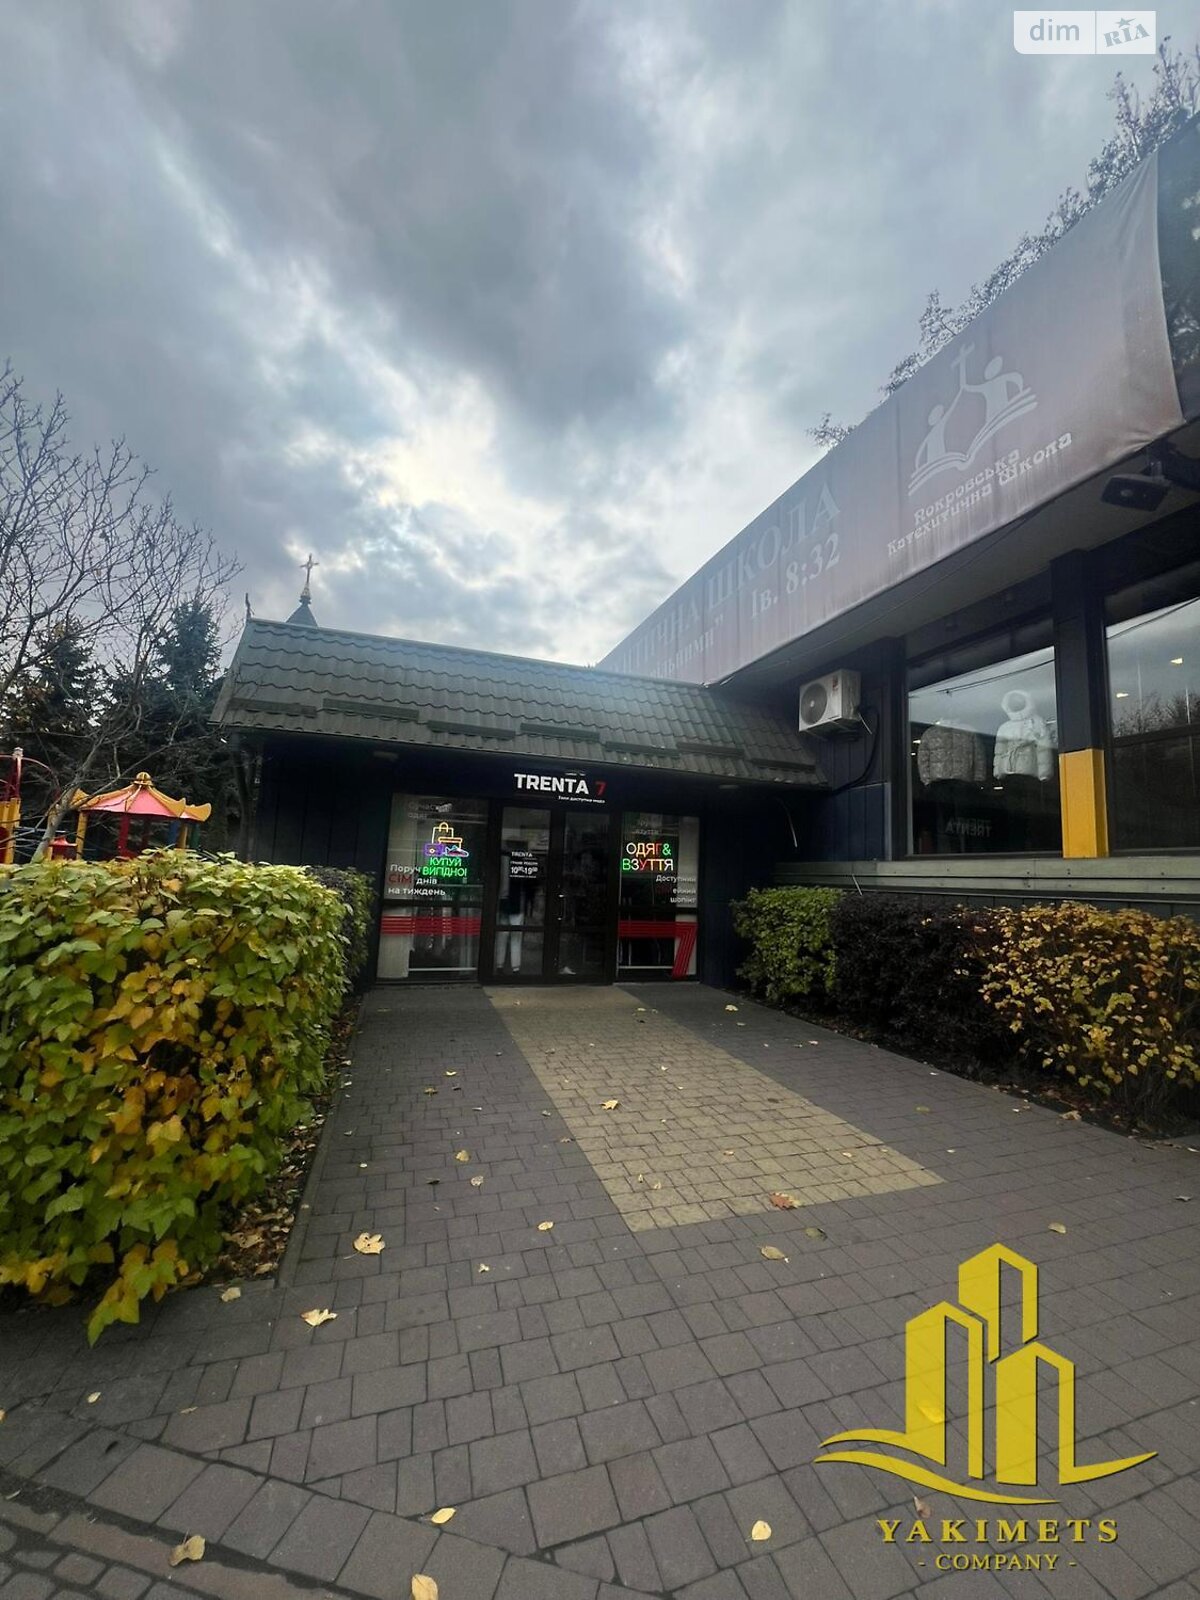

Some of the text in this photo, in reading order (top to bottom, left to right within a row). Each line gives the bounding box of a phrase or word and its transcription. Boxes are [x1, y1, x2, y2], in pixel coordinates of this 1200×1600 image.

[707, 482, 842, 611] ШКОЛА
[785, 533, 841, 595] 8:32
[513, 773, 607, 797] TRENTA 7
[626, 842, 671, 858] ОДЯГ &
[429, 857, 462, 867] КУПУЙ
[622, 858, 674, 871] ВЗУТТЯ
[389, 864, 421, 875] Поруч
[416, 876, 438, 886] днів
[387, 887, 447, 897] на тиждень
